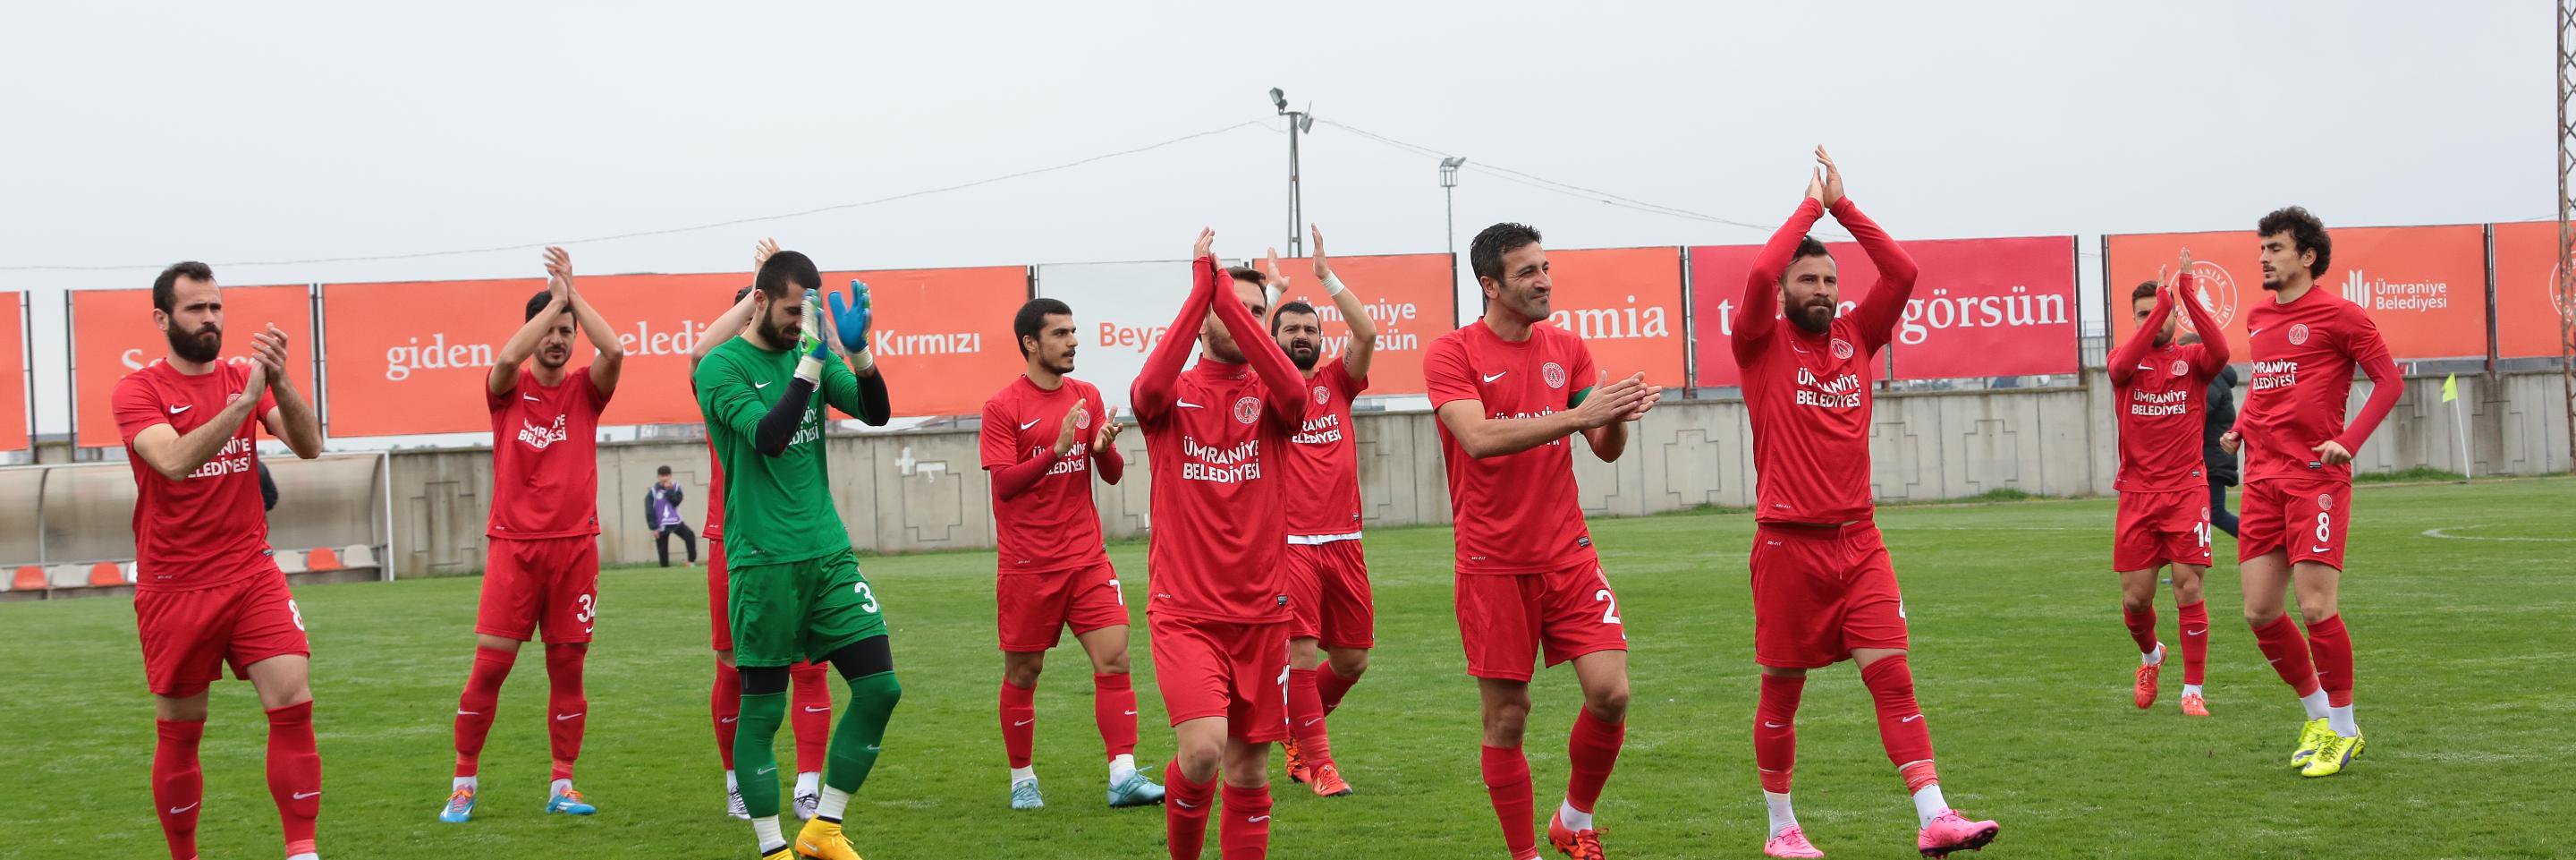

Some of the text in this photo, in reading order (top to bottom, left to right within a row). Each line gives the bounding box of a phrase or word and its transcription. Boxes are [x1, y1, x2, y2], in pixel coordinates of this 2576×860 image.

[2375, 277, 2447, 297] Ümraniye
[1548, 294, 1669, 339] amia
[1899, 285, 2069, 345] görsün
[2376, 294, 2447, 312] Belediyesi
[875, 329, 981, 356] Kırmızı
[386, 332, 496, 382] giden
[2251, 358, 2298, 374] MRANİYE
[2131, 401, 2186, 416] BELEDİYESİ
[2133, 388, 2187, 404] ÜMRANİYE
[1183, 435, 1259, 464] ÜMRANİYE
[1182, 457, 1261, 484] BELEDİYESİ
[2316, 511, 2330, 542] 8
[853, 581, 881, 614] 3
